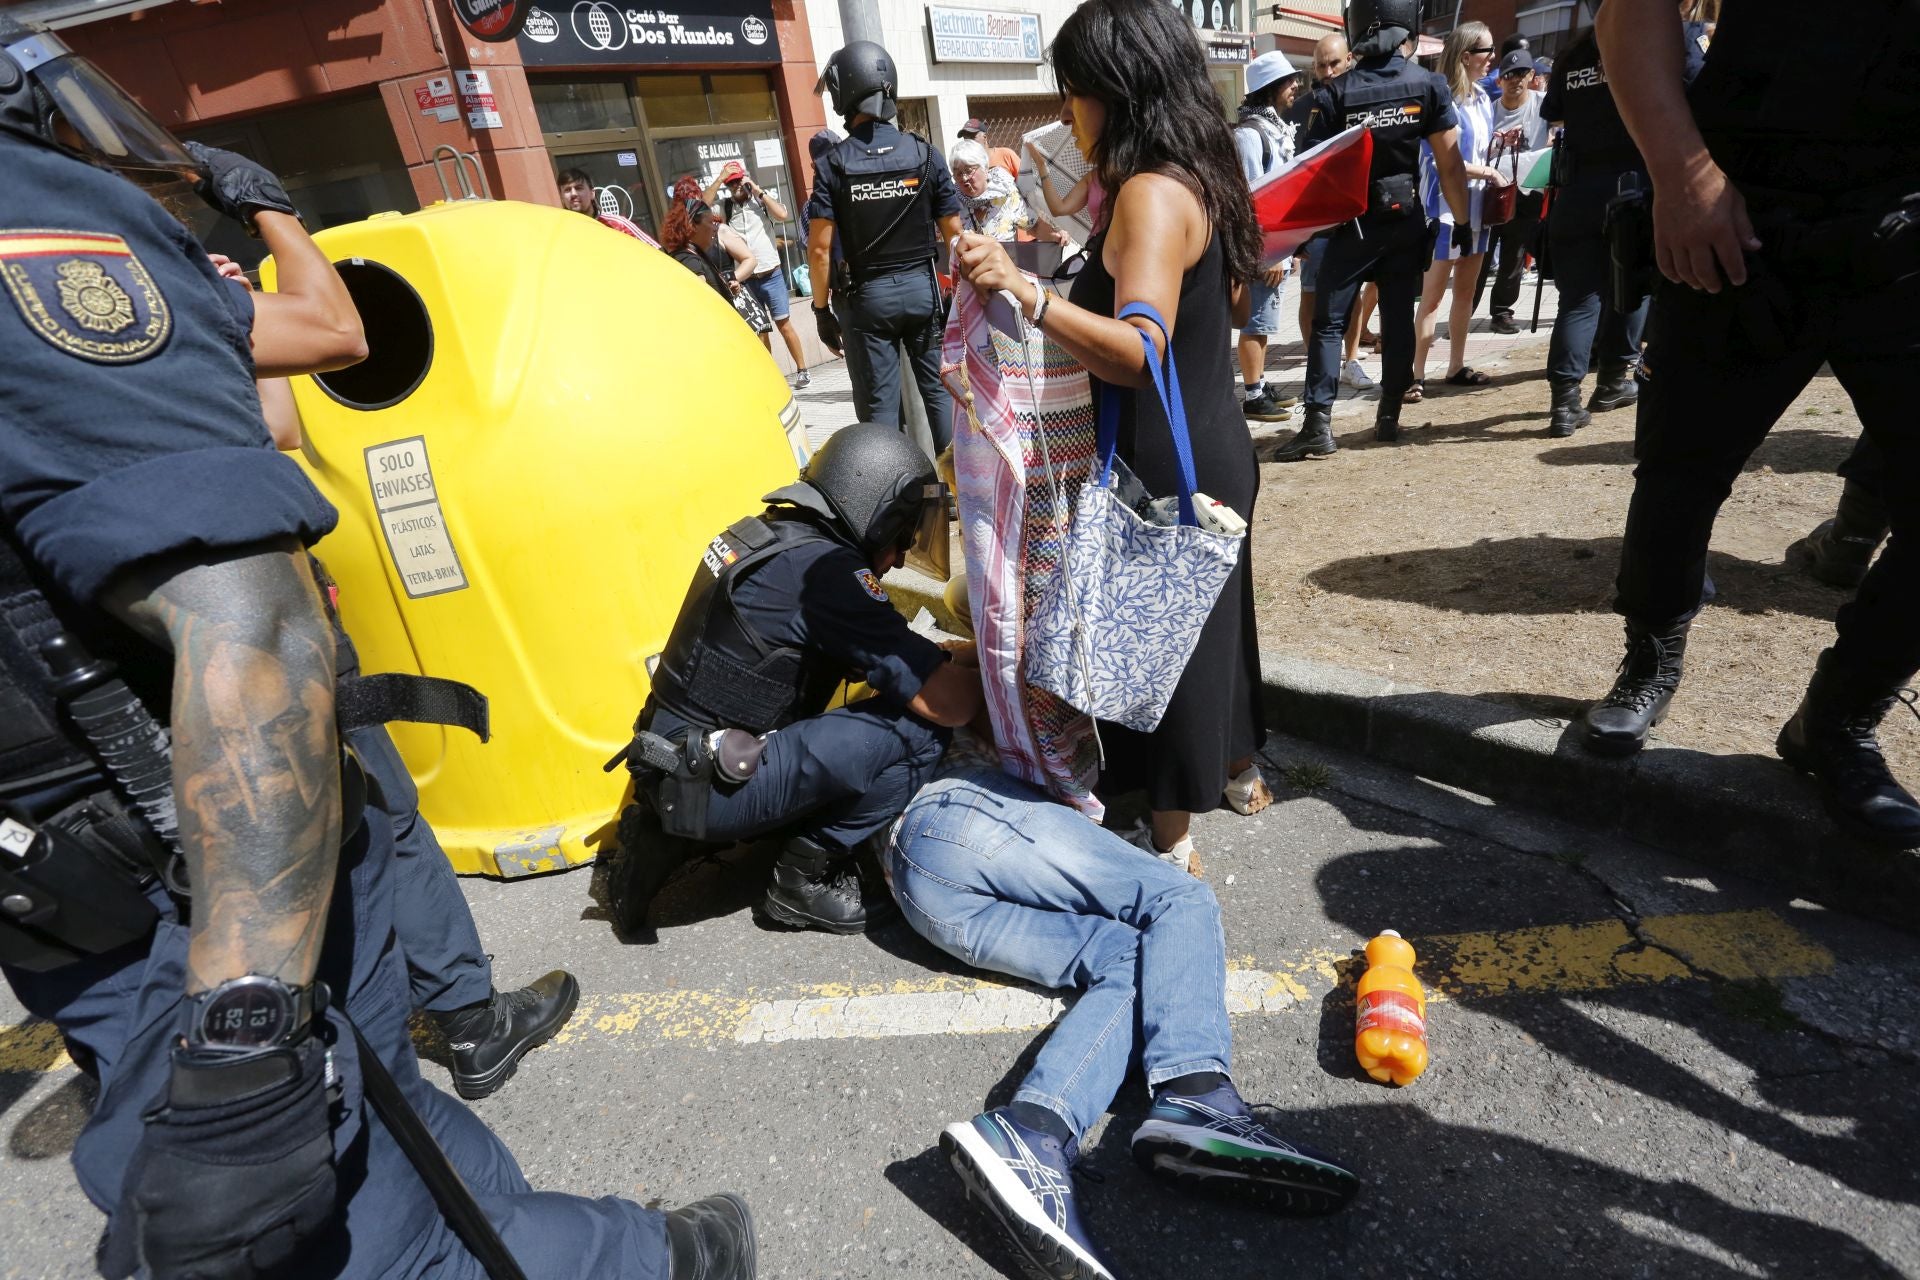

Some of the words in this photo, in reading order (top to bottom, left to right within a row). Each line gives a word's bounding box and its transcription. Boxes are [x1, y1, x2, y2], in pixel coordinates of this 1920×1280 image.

[626, 9, 656, 24] Café
[657, 10, 679, 24] Bar
[528, 25, 555, 35] Galicia
[629, 24, 666, 44] Dos
[668, 25, 734, 45] Mundos
[698, 145, 709, 159] SE
[709, 142, 741, 158] ALQUILA
[850, 179, 906, 193] POLICIA
[851, 187, 919, 202] NACIONAL
[56, 328, 150, 354] NACIONAL
[379, 451, 415, 473] SOLO
[375, 472, 432, 499] ENVASES
[409, 543, 436, 558] LATAS
[407, 566, 458, 585] TETRA-BRIK
[224, 1007, 244, 1029] 52
[249, 1006, 268, 1027] 13
